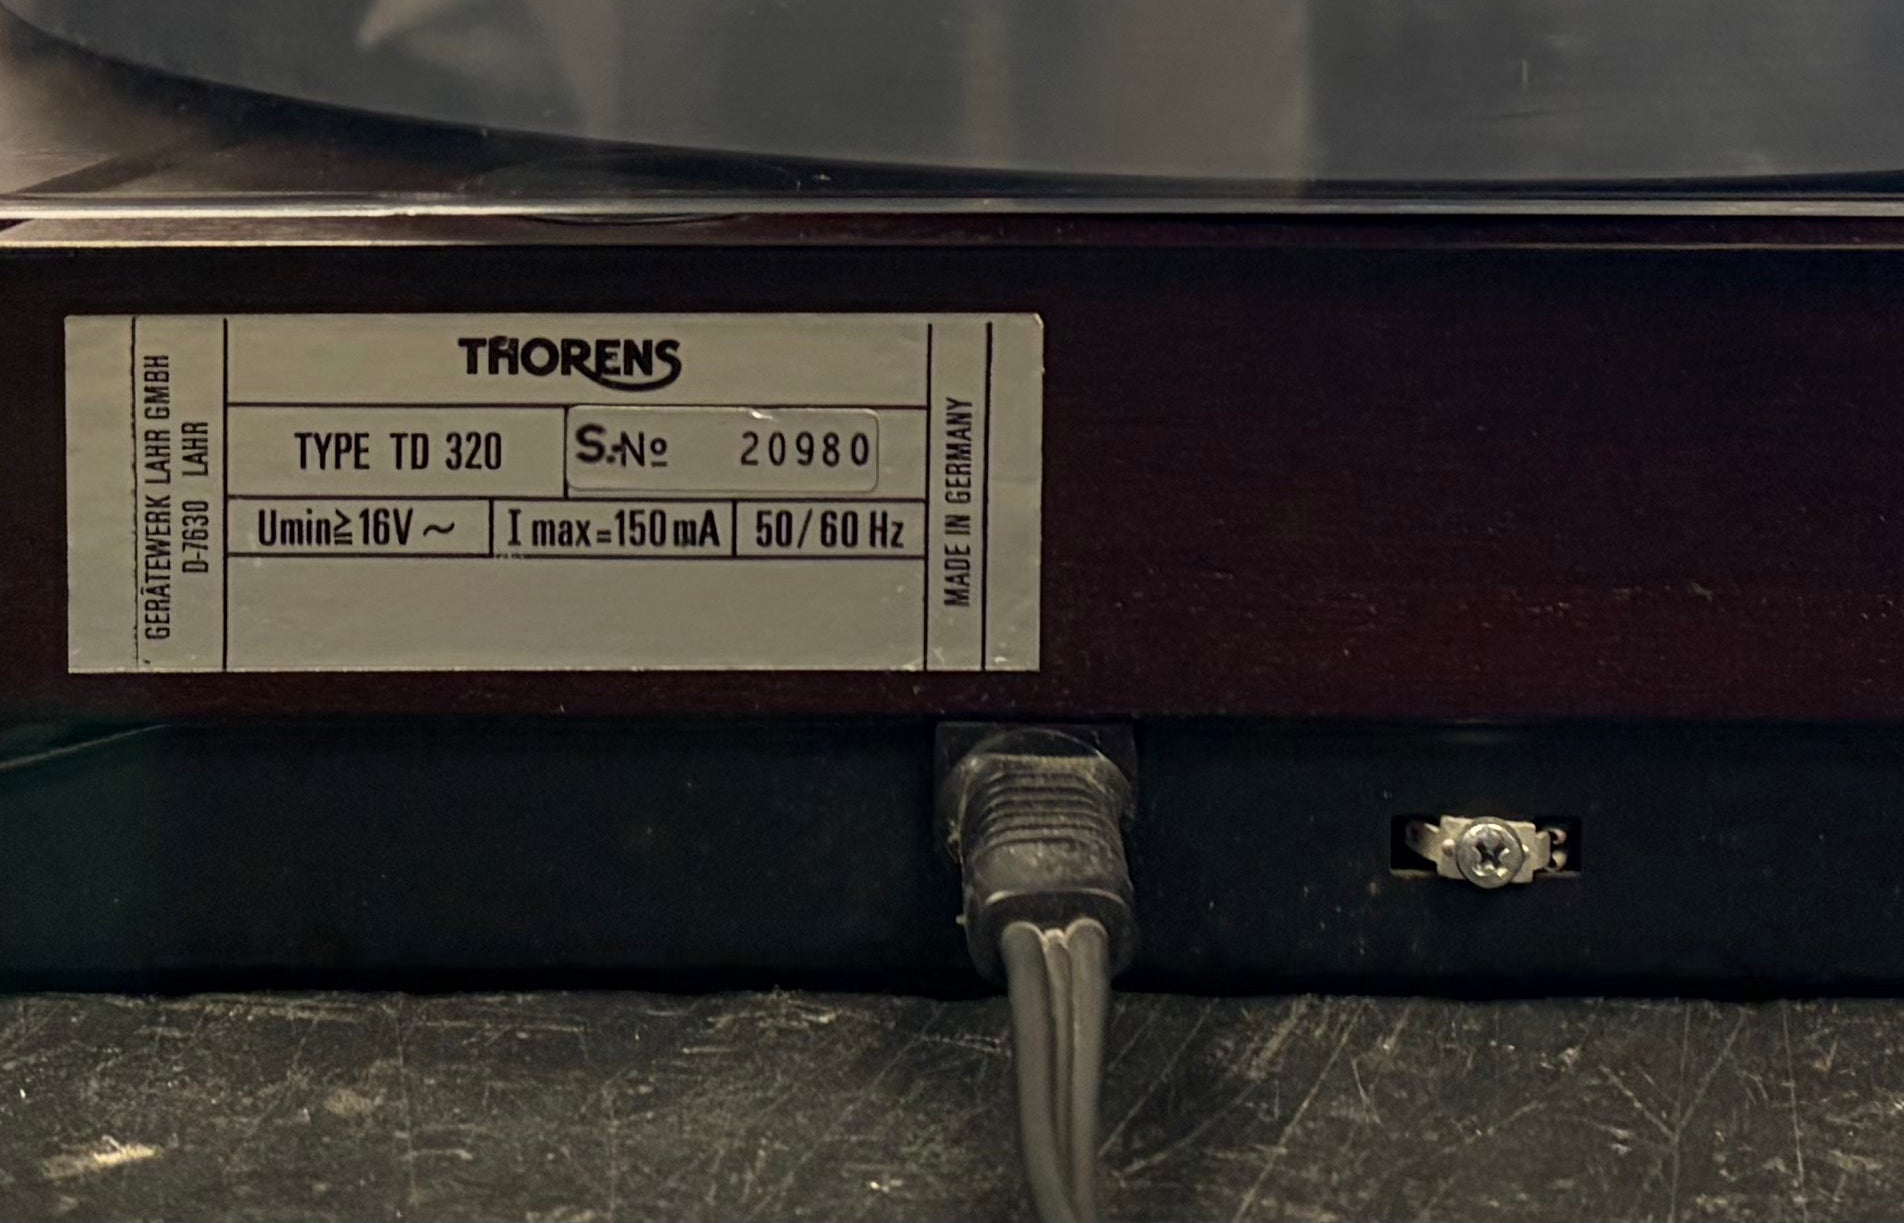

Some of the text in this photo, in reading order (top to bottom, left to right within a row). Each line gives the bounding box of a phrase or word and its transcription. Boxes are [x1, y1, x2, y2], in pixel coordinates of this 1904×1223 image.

[143, 354, 171, 420] GMBH
[457, 334, 683, 393] THORENS
[143, 429, 172, 485] LAHR
[293, 431, 502, 471] TYPE TD 320
[740, 430, 870, 468] 20980
[180, 421, 210, 574] D-7630 LAHR
[942, 396, 973, 608] MADE IN GERMANY
[868, 509, 905, 549] Hz
